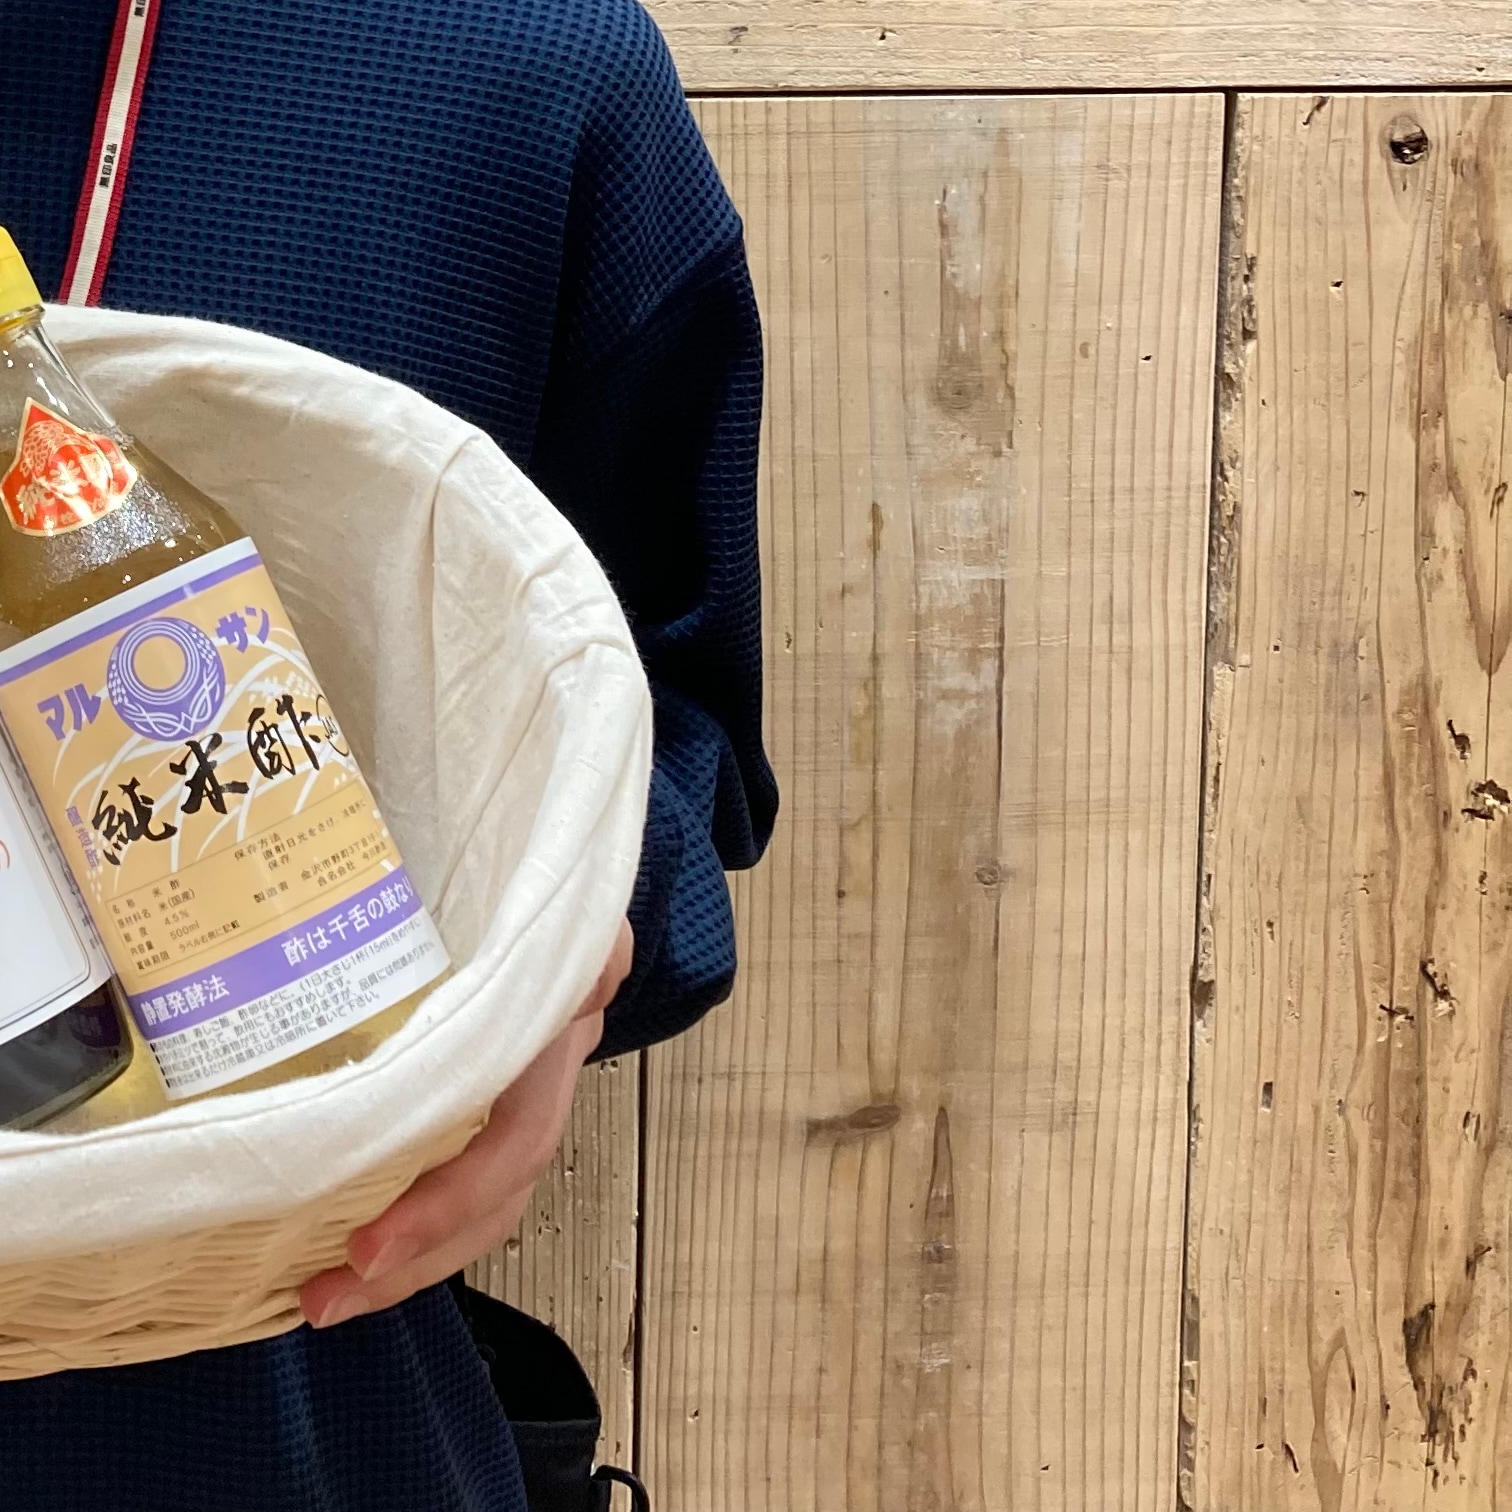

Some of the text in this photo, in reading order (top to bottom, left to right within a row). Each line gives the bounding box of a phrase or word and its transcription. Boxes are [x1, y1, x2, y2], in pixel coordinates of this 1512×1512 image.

[215, 606, 270, 653] サン
[37, 683, 101, 741] マル
[92, 694, 321, 866] 純米酢
[169, 921, 200, 940] 500ml
[141, 974, 230, 1026] 静置発酵法
